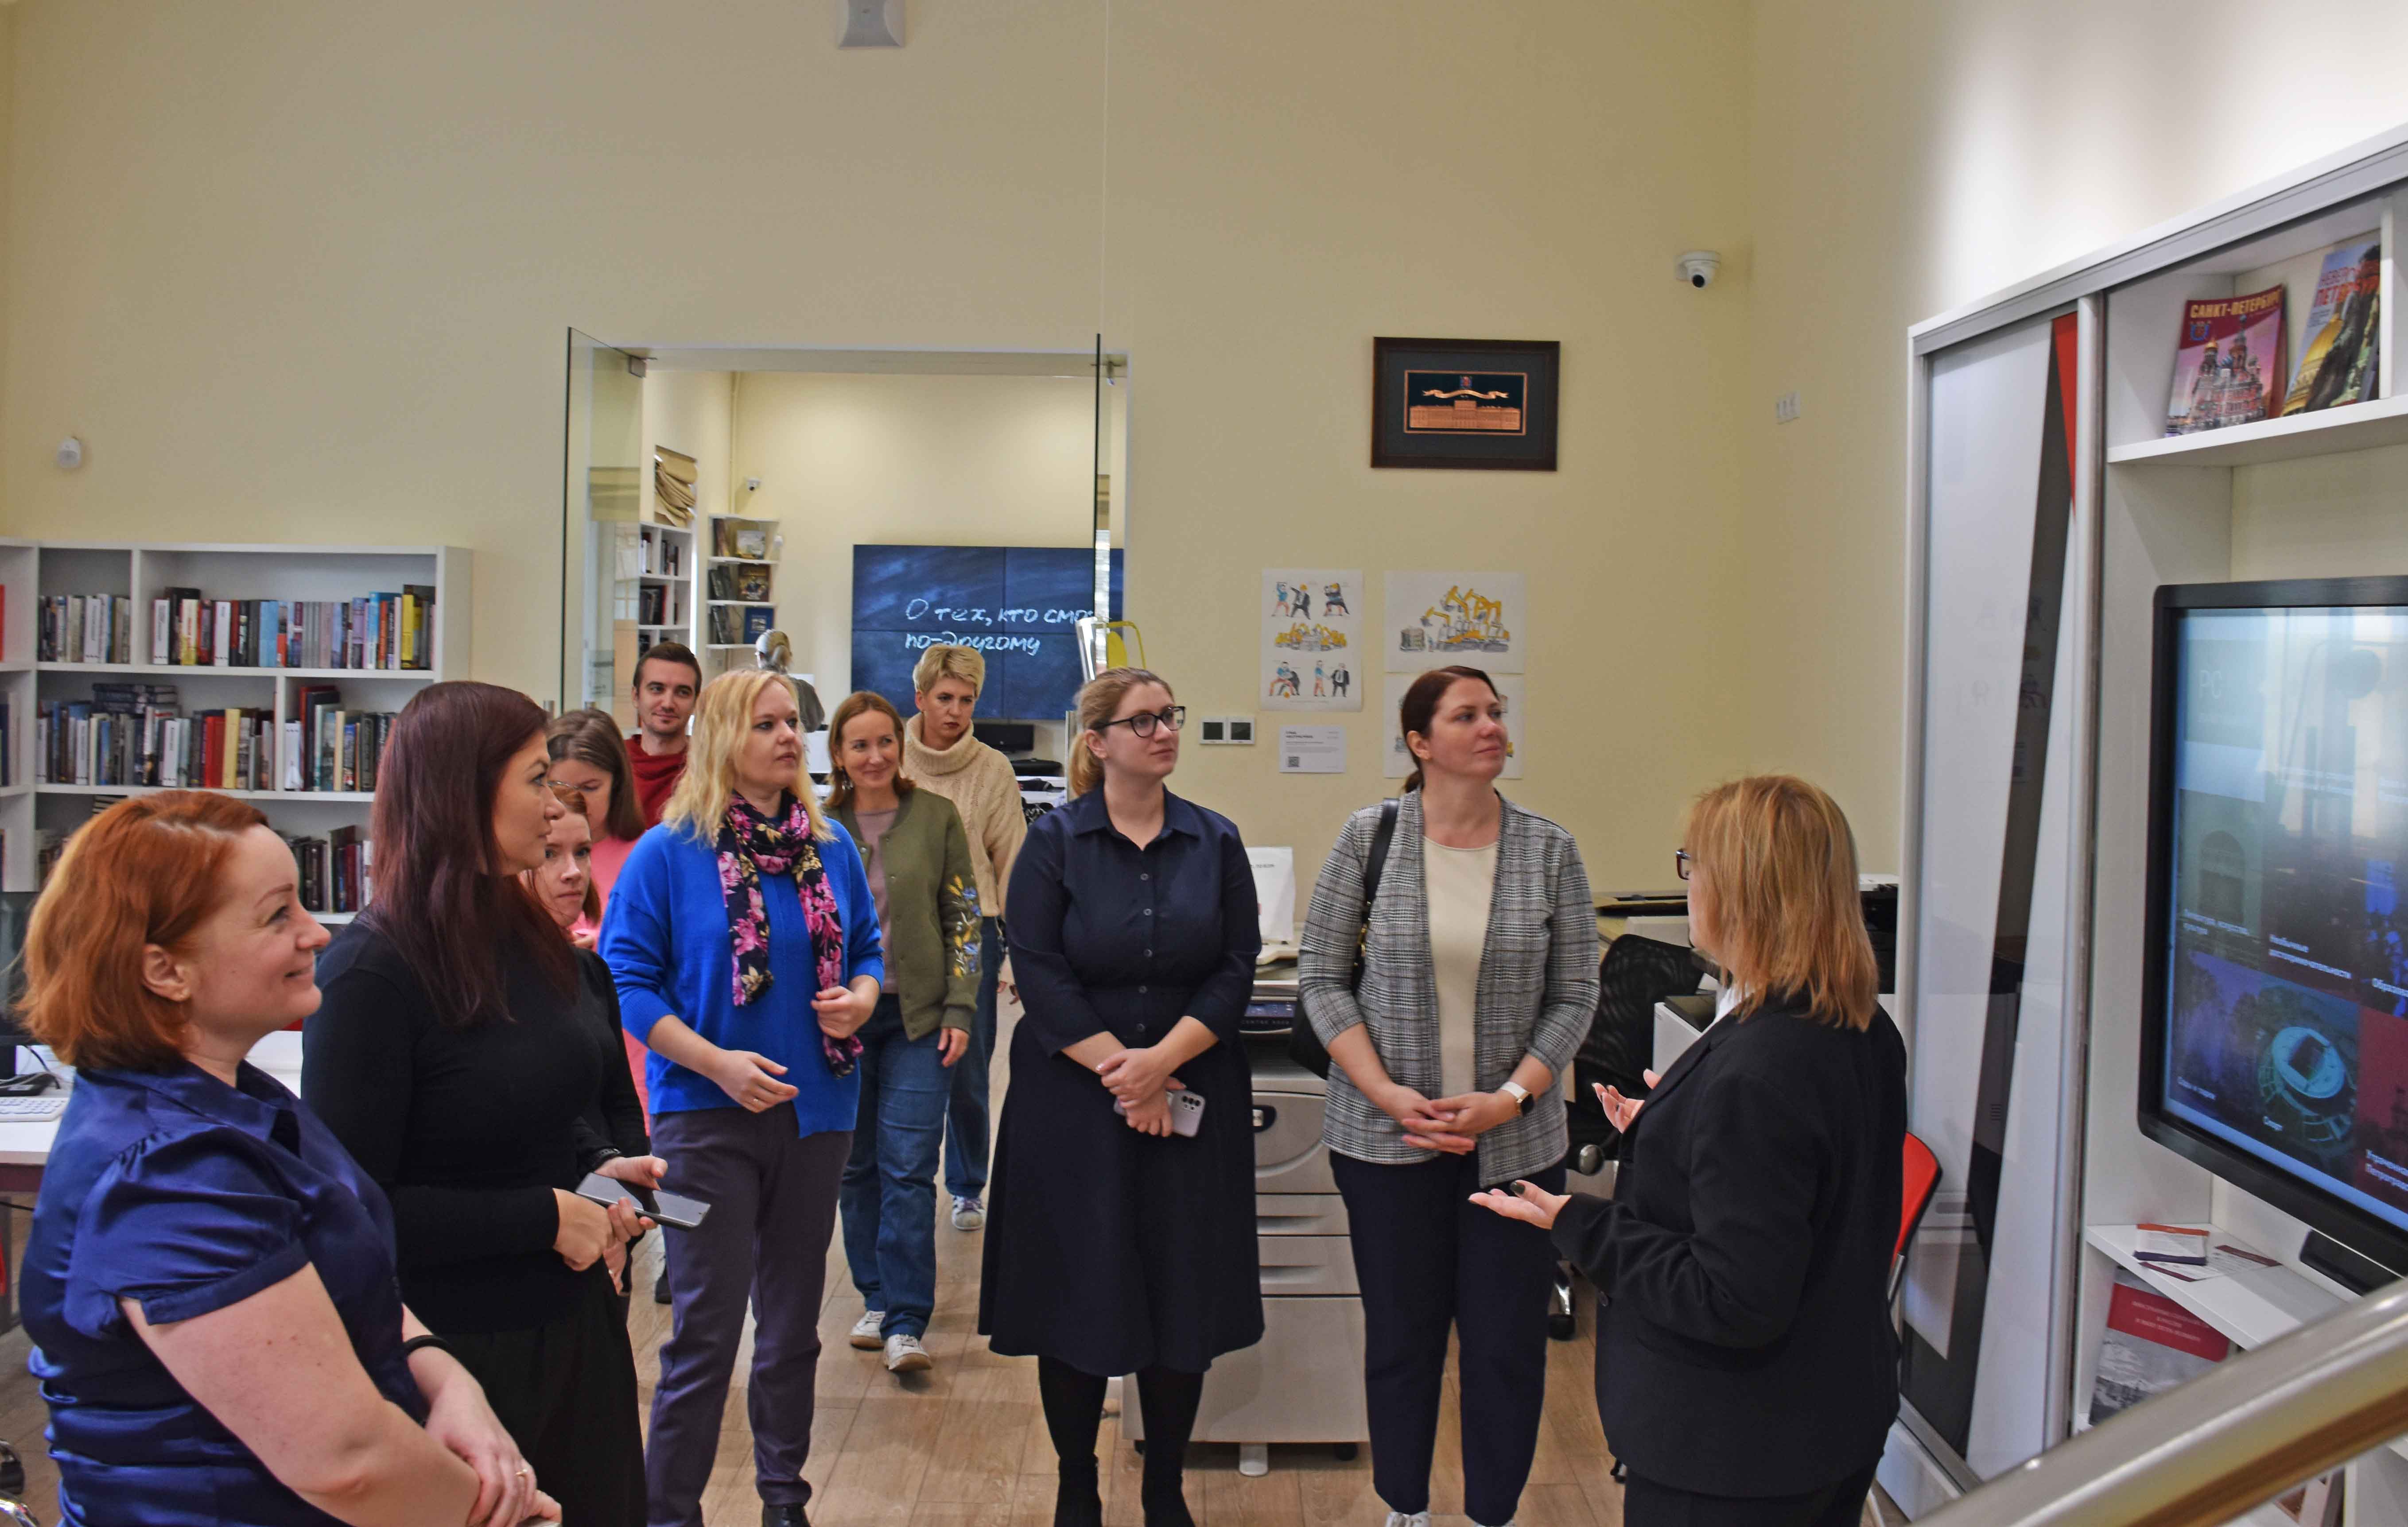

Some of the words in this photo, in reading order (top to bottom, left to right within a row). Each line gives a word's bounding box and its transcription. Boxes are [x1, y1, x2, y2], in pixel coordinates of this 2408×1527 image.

[905, 598, 929, 620] О
[934, 608, 993, 626] тех,
[998, 608, 1039, 623] кто
[1043, 608, 1094, 624] смо
